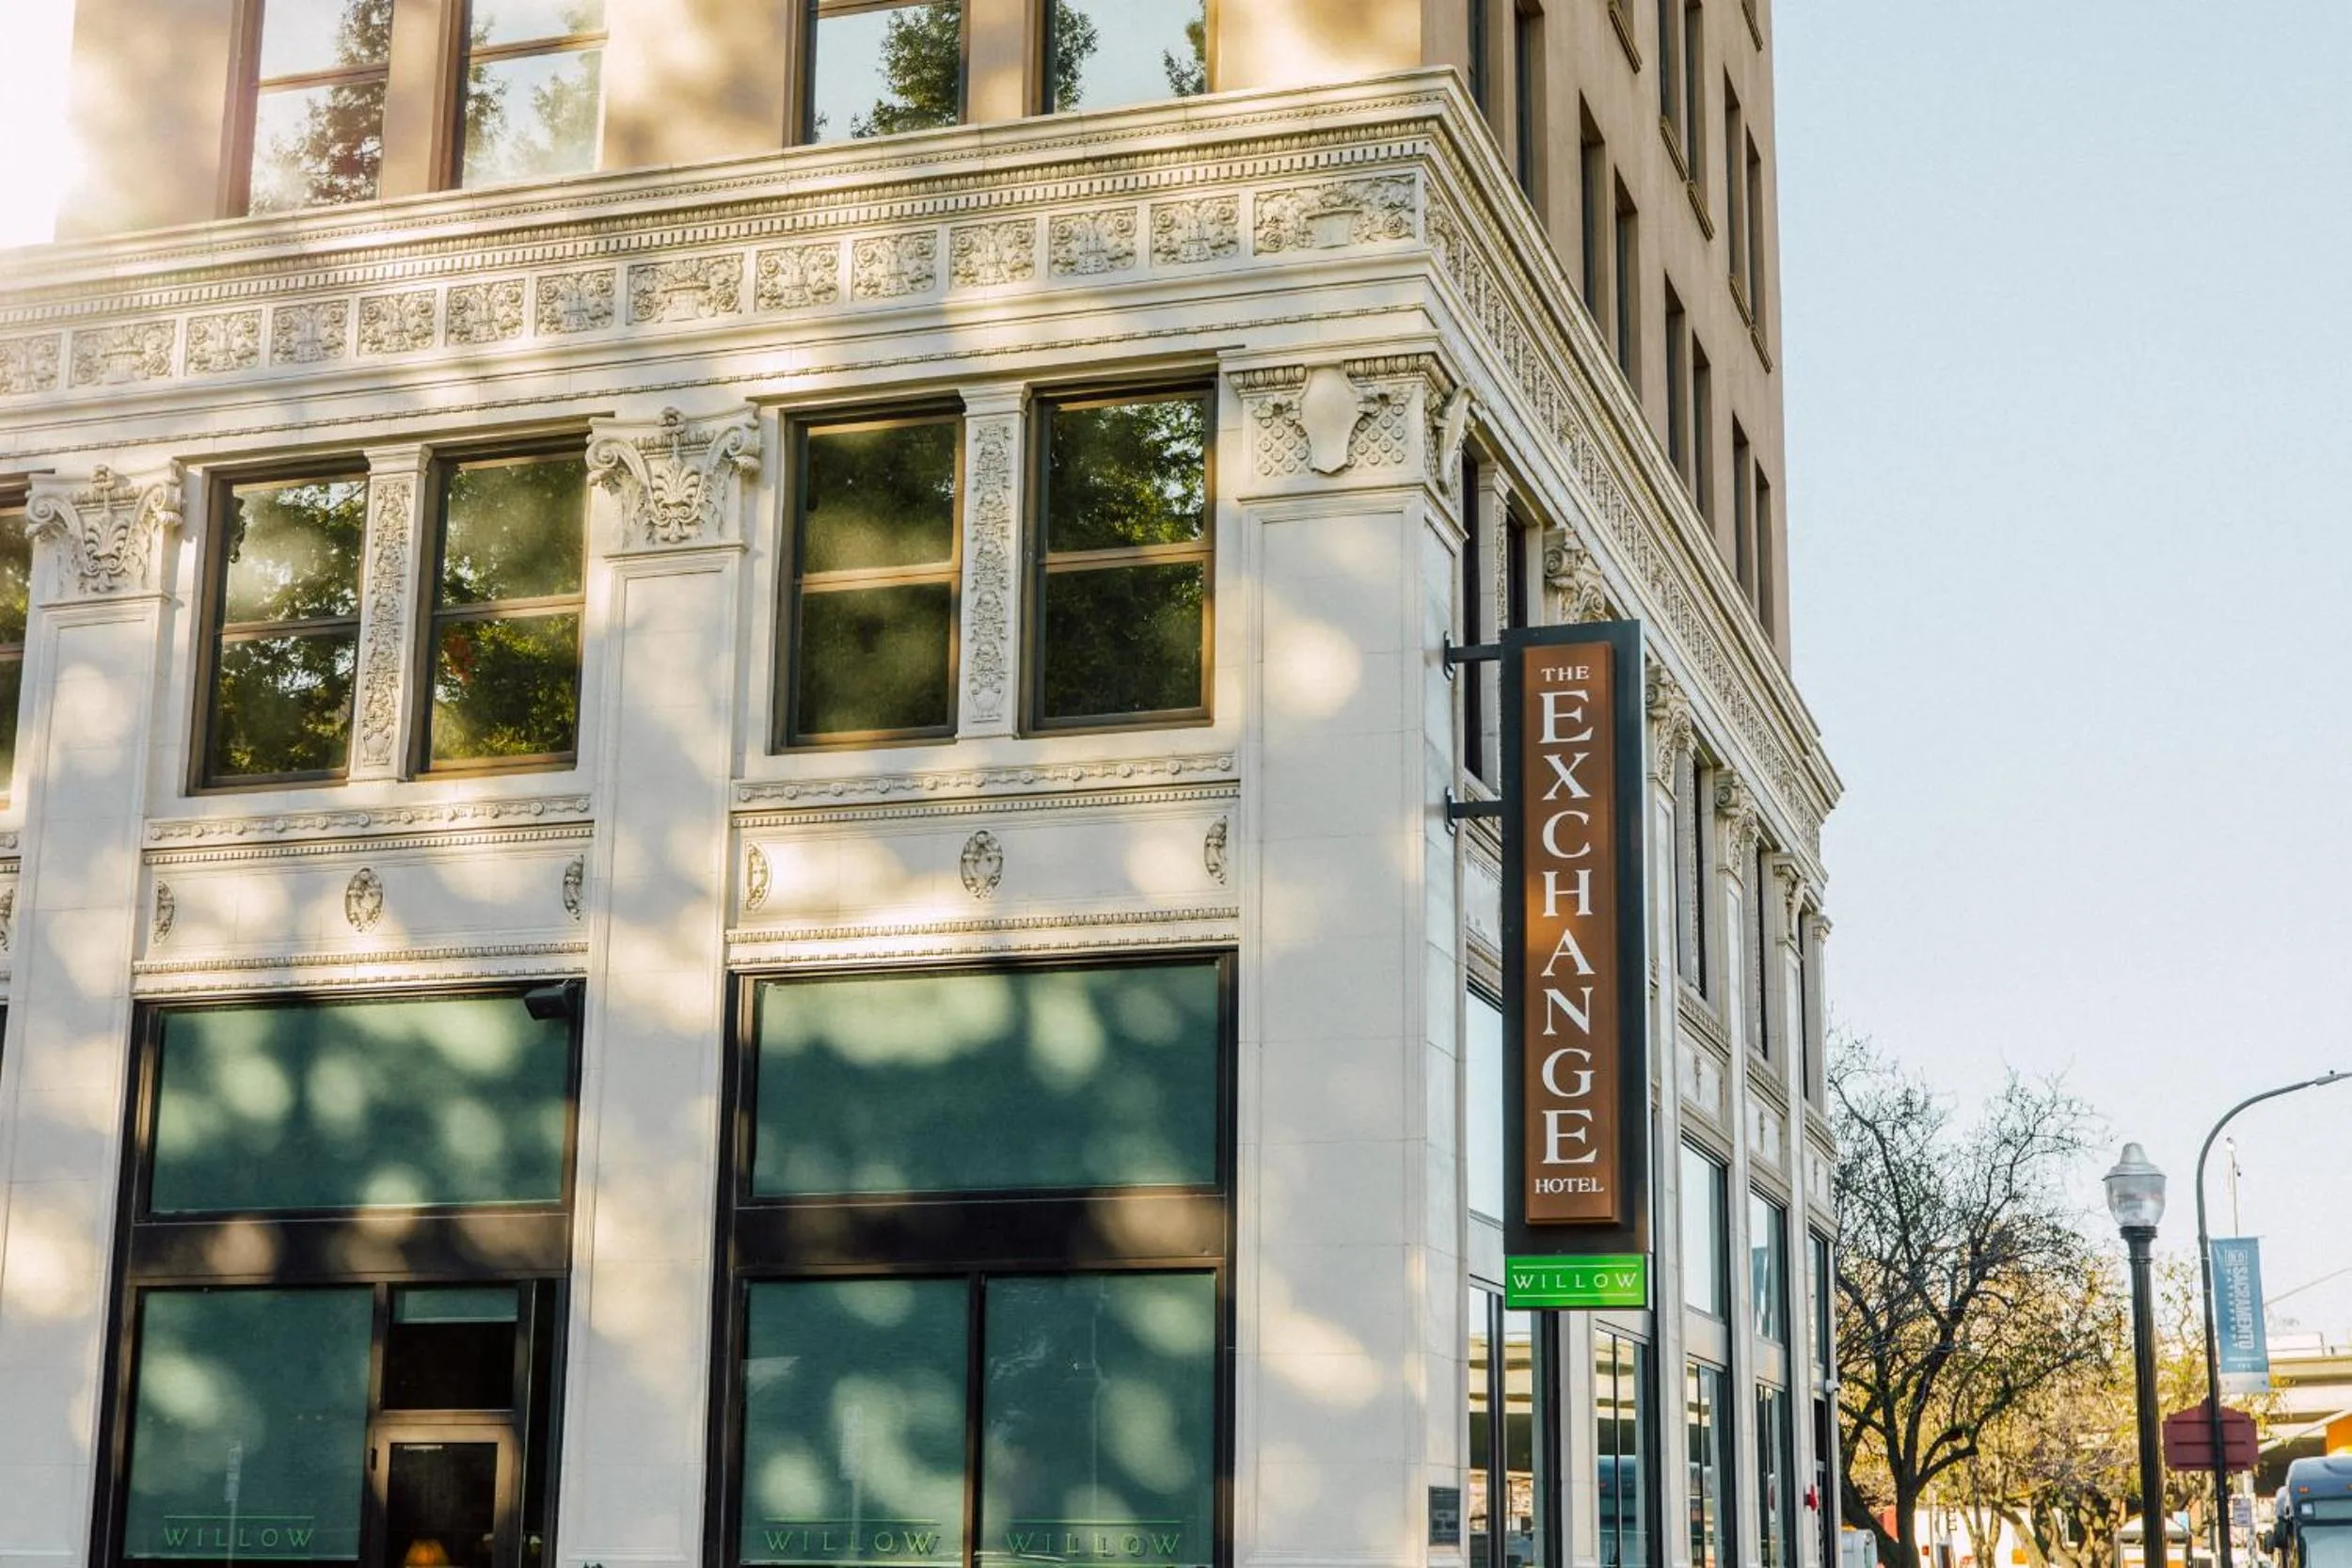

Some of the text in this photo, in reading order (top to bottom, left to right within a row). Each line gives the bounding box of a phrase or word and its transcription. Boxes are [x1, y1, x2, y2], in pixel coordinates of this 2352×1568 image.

[1540, 665, 1590, 683] THE
[1537, 689, 1597, 1164] EXCHANGE
[1534, 1177, 1605, 1195] HOTEL
[1513, 1273, 1638, 1290] WILLOW
[2233, 1265, 2254, 1350] SACRAMENTO
[163, 1528, 314, 1547] WILLOW
[764, 1530, 934, 1552] WILLOW
[1006, 1532, 1181, 1555] WILLOW
